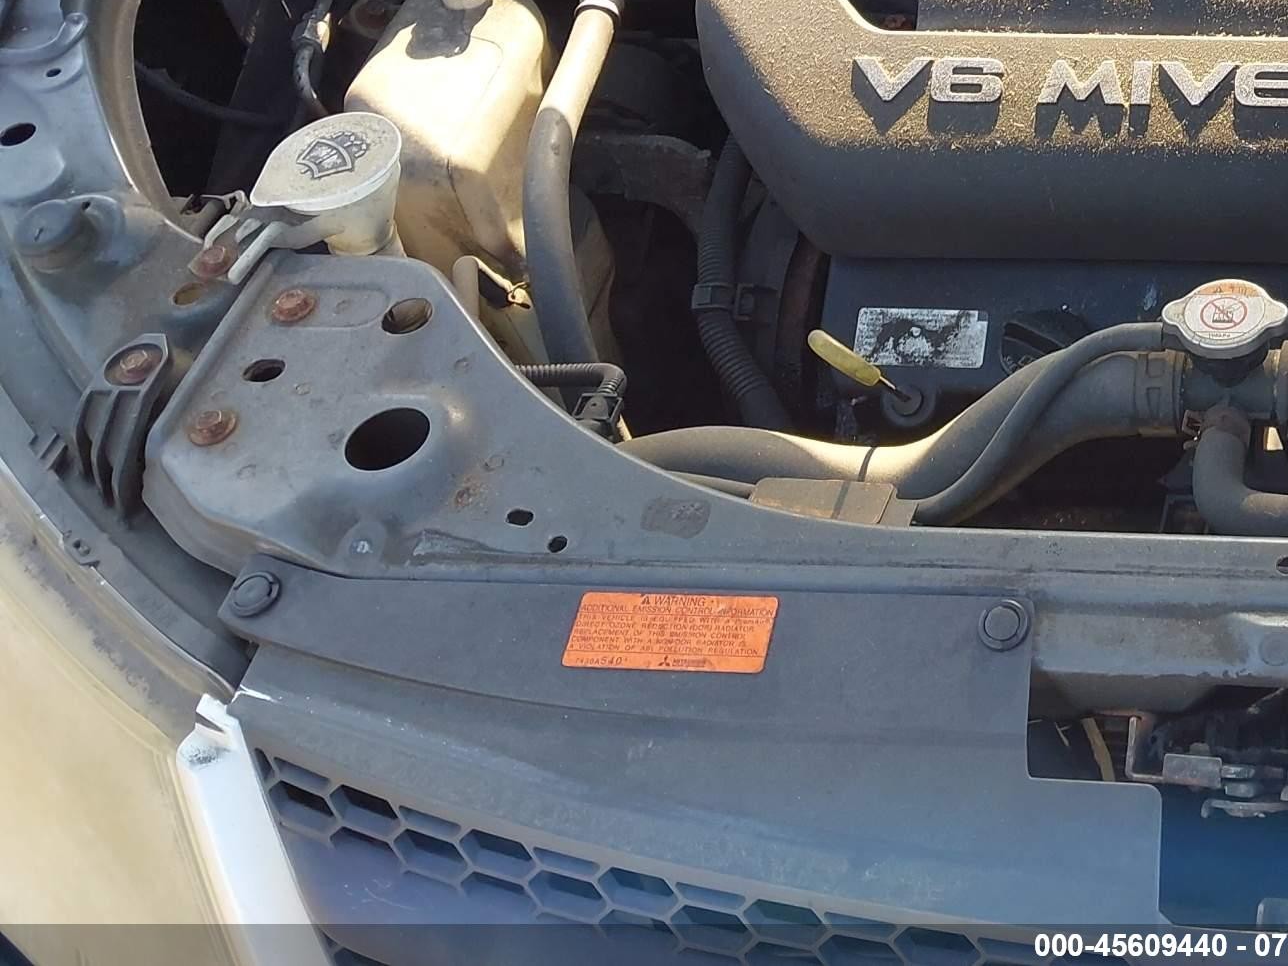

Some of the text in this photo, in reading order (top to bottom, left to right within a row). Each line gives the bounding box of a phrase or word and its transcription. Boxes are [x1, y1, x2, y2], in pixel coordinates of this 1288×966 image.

[853, 57, 1003, 102] V6
[654, 596, 706, 606] WARNING
[632, 605, 672, 613] EMISSION
[676, 606, 714, 614] CONTROL
